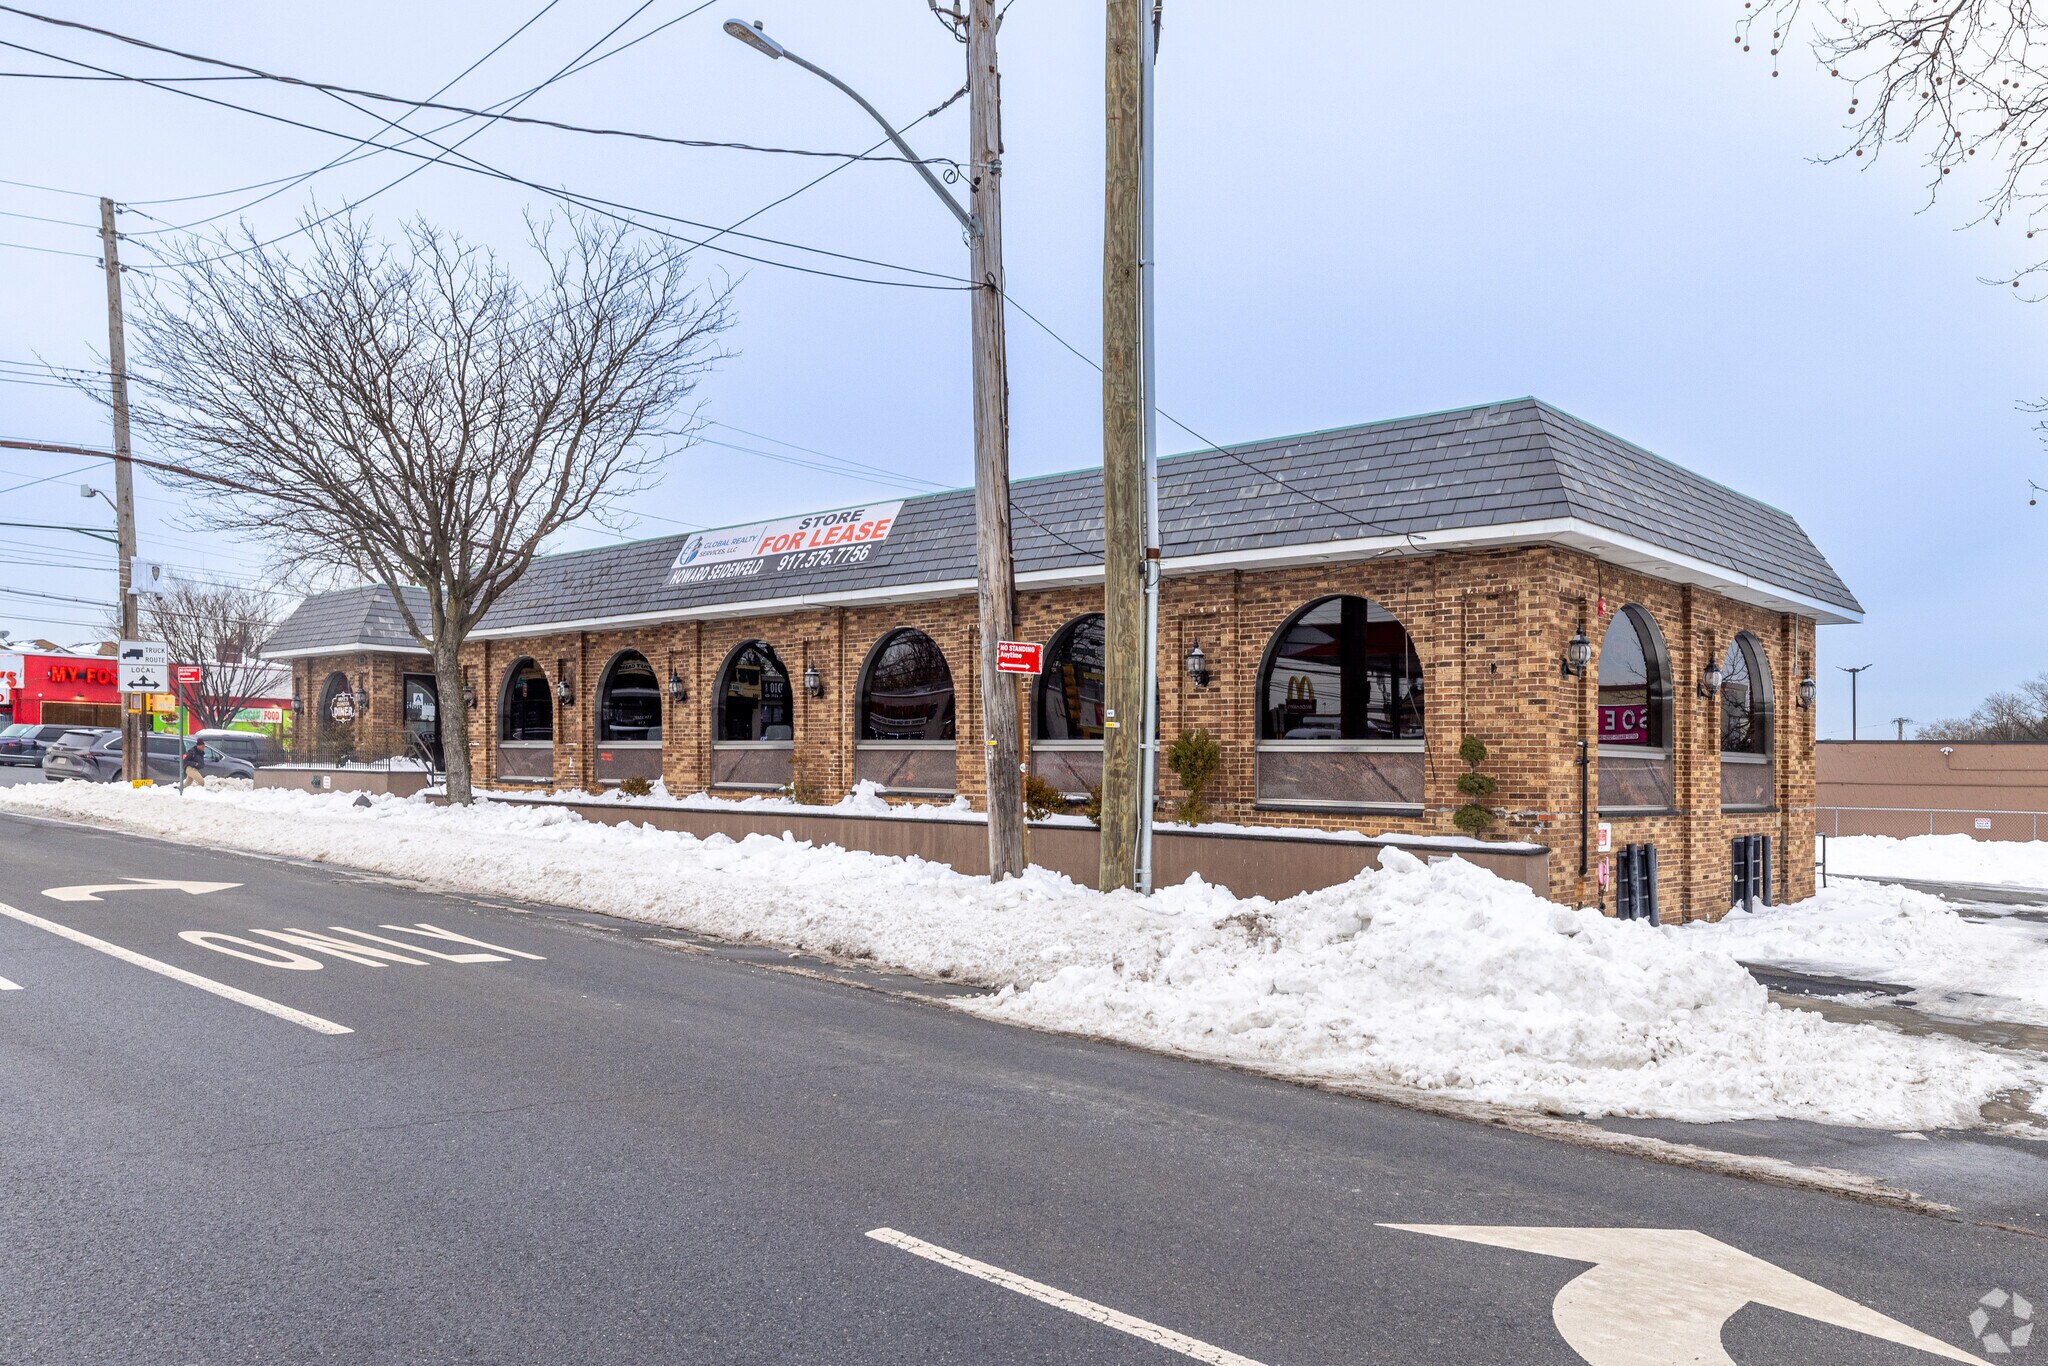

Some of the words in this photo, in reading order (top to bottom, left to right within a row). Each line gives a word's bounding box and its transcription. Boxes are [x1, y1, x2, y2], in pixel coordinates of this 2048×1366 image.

[799, 509, 865, 530] STORE
[704, 540, 730, 549] GLOBAL
[731, 535, 758, 546] REALTY
[757, 531, 806, 555] FOR
[808, 519, 891, 547] LEASE
[777, 544, 872, 571] 917.575.7756
[669, 566, 710, 585] HOWARD
[1000, 651, 1022, 659] Anytime
[1009, 645, 1035, 653] STANDING
[51, 665, 78, 683] MY
[264, 710, 280, 720] FOOD
[178, 923, 547, 971] ONLY
